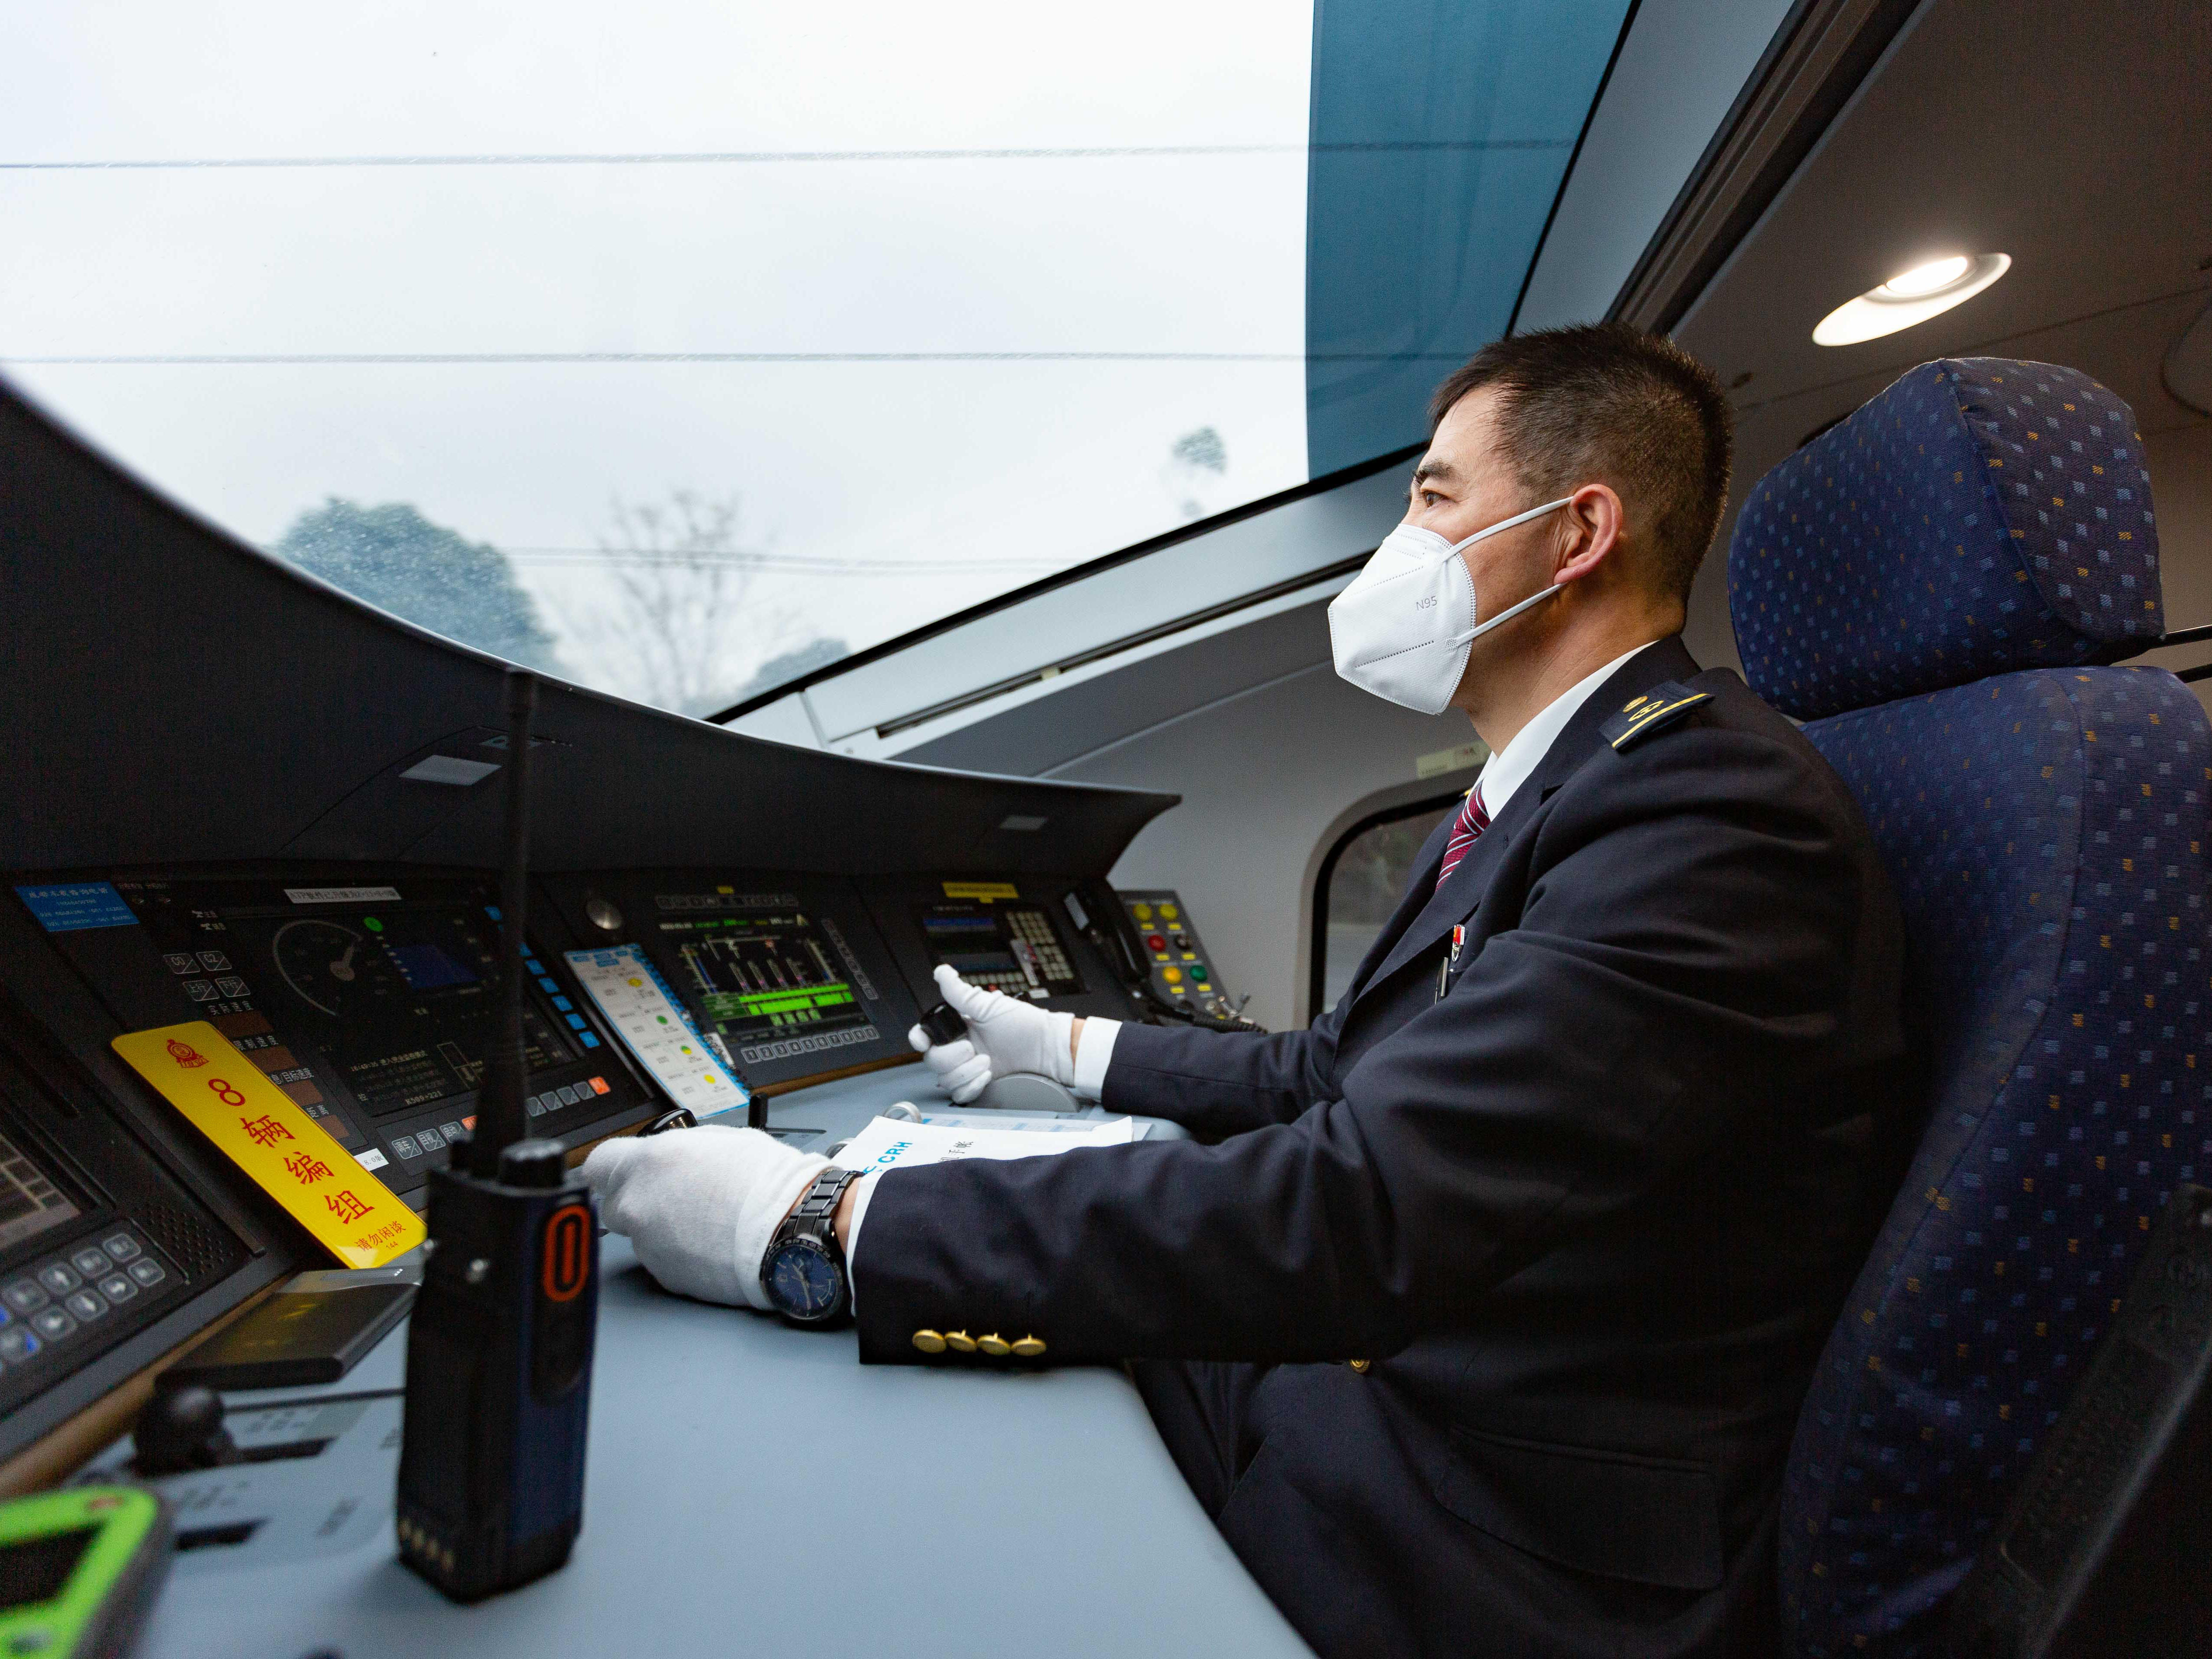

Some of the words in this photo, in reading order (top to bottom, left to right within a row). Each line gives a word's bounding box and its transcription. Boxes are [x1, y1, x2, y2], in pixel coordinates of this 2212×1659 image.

[1416, 595, 1437, 611] N95
[190, 983, 208, 993] 上行
[208, 1000, 254, 1017] 实际速度
[269, 1067, 315, 1085] 息/目标速度
[208, 1078, 375, 1224] 8辆编组
[877, 1141, 913, 1163] CRH
[354, 1220, 406, 1252] 请勿闲谈
